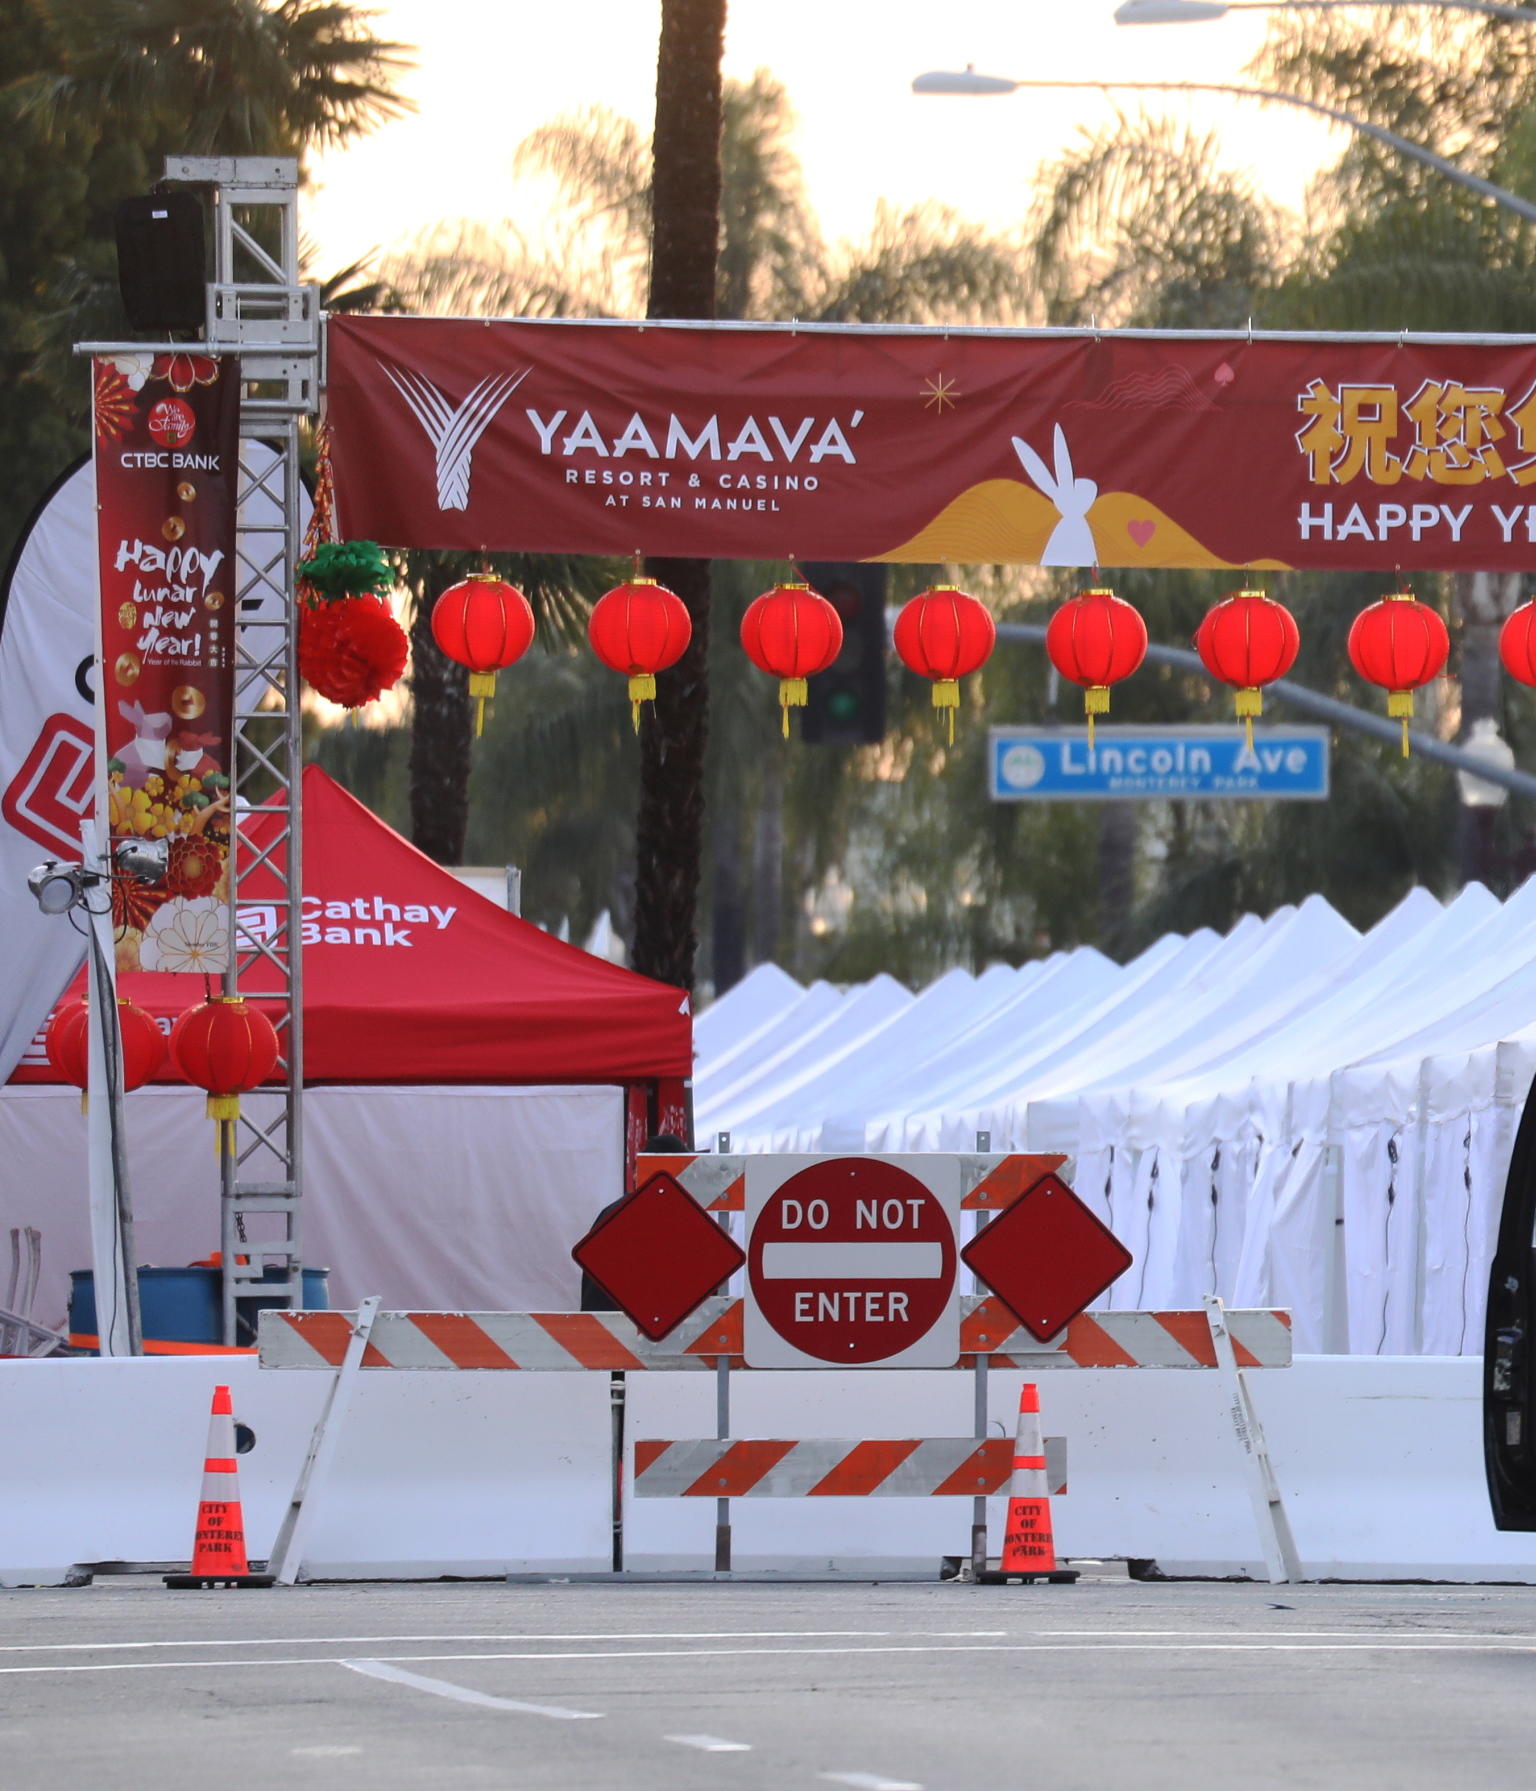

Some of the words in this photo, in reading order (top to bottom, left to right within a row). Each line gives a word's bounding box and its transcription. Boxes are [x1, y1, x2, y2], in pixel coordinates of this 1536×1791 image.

[121, 452, 169, 468] CTBC
[172, 453, 220, 471] BANK
[565, 468, 671, 488] RESORT
[688, 473, 702, 489] &
[719, 473, 820, 492] CASINO
[605, 495, 629, 507] AT
[642, 495, 682, 509] SAN
[695, 497, 781, 512] MANUEL
[1297, 502, 1473, 543] HAPPY
[114, 538, 225, 598] Happy
[133, 579, 198, 603] Lunar
[143, 605, 196, 629] New
[137, 627, 202, 664] Year!
[1060, 743, 1212, 775] Lincoln
[1233, 745, 1308, 775] Ave
[301, 896, 458, 929] Cathay
[301, 923, 414, 947] Bank
[781, 1199, 830, 1230] DO
[856, 1199, 925, 1230] NOT
[794, 1292, 909, 1323] ENTER
[201, 1504, 227, 1514] CITY
[1014, 1505, 1042, 1516] CITY
[207, 1516, 224, 1527] OF
[1020, 1518, 1037, 1529] OF
[198, 1543, 233, 1553] PARK
[1012, 1545, 1046, 1557] PARK
